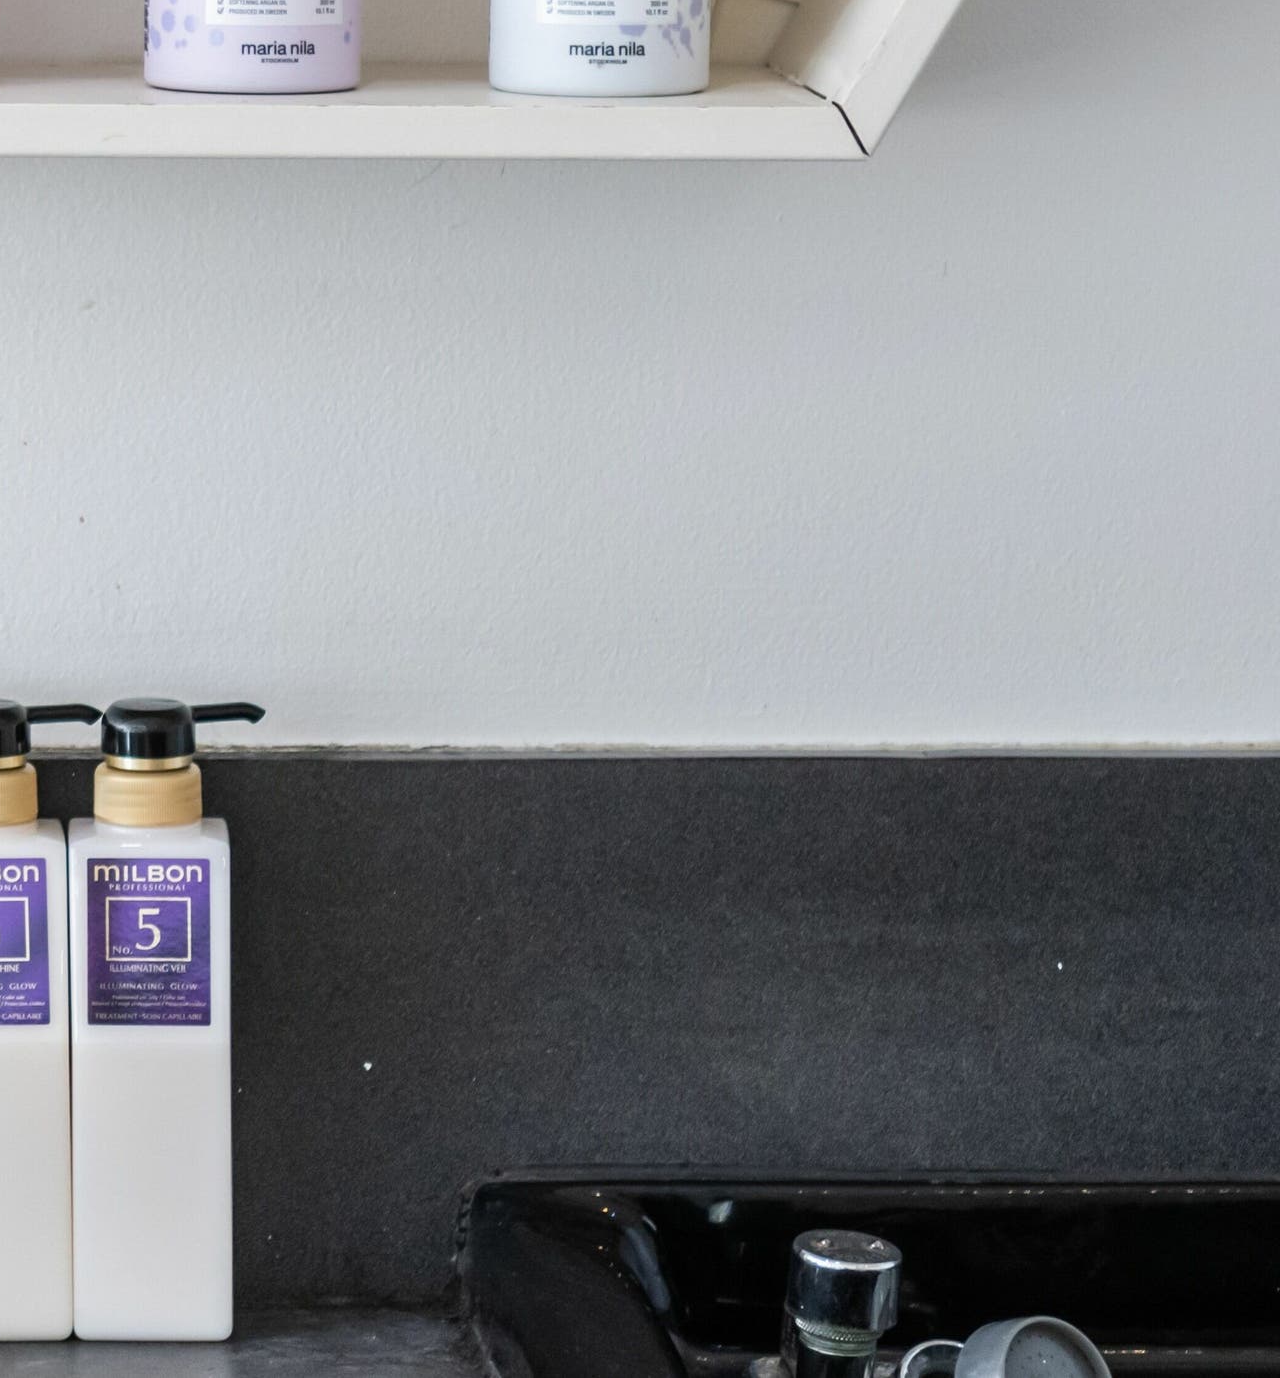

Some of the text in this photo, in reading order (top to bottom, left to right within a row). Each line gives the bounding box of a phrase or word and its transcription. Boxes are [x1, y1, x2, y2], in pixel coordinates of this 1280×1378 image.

[241, 39, 315, 55] maria nila
[569, 41, 645, 56] maria nila
[112, 908, 161, 955] No. 5
[110, 963, 186, 973] ILLUMINATING VEIL
[9, 982, 37, 990] GLOW
[100, 982, 164, 990] ILLUMINATING
